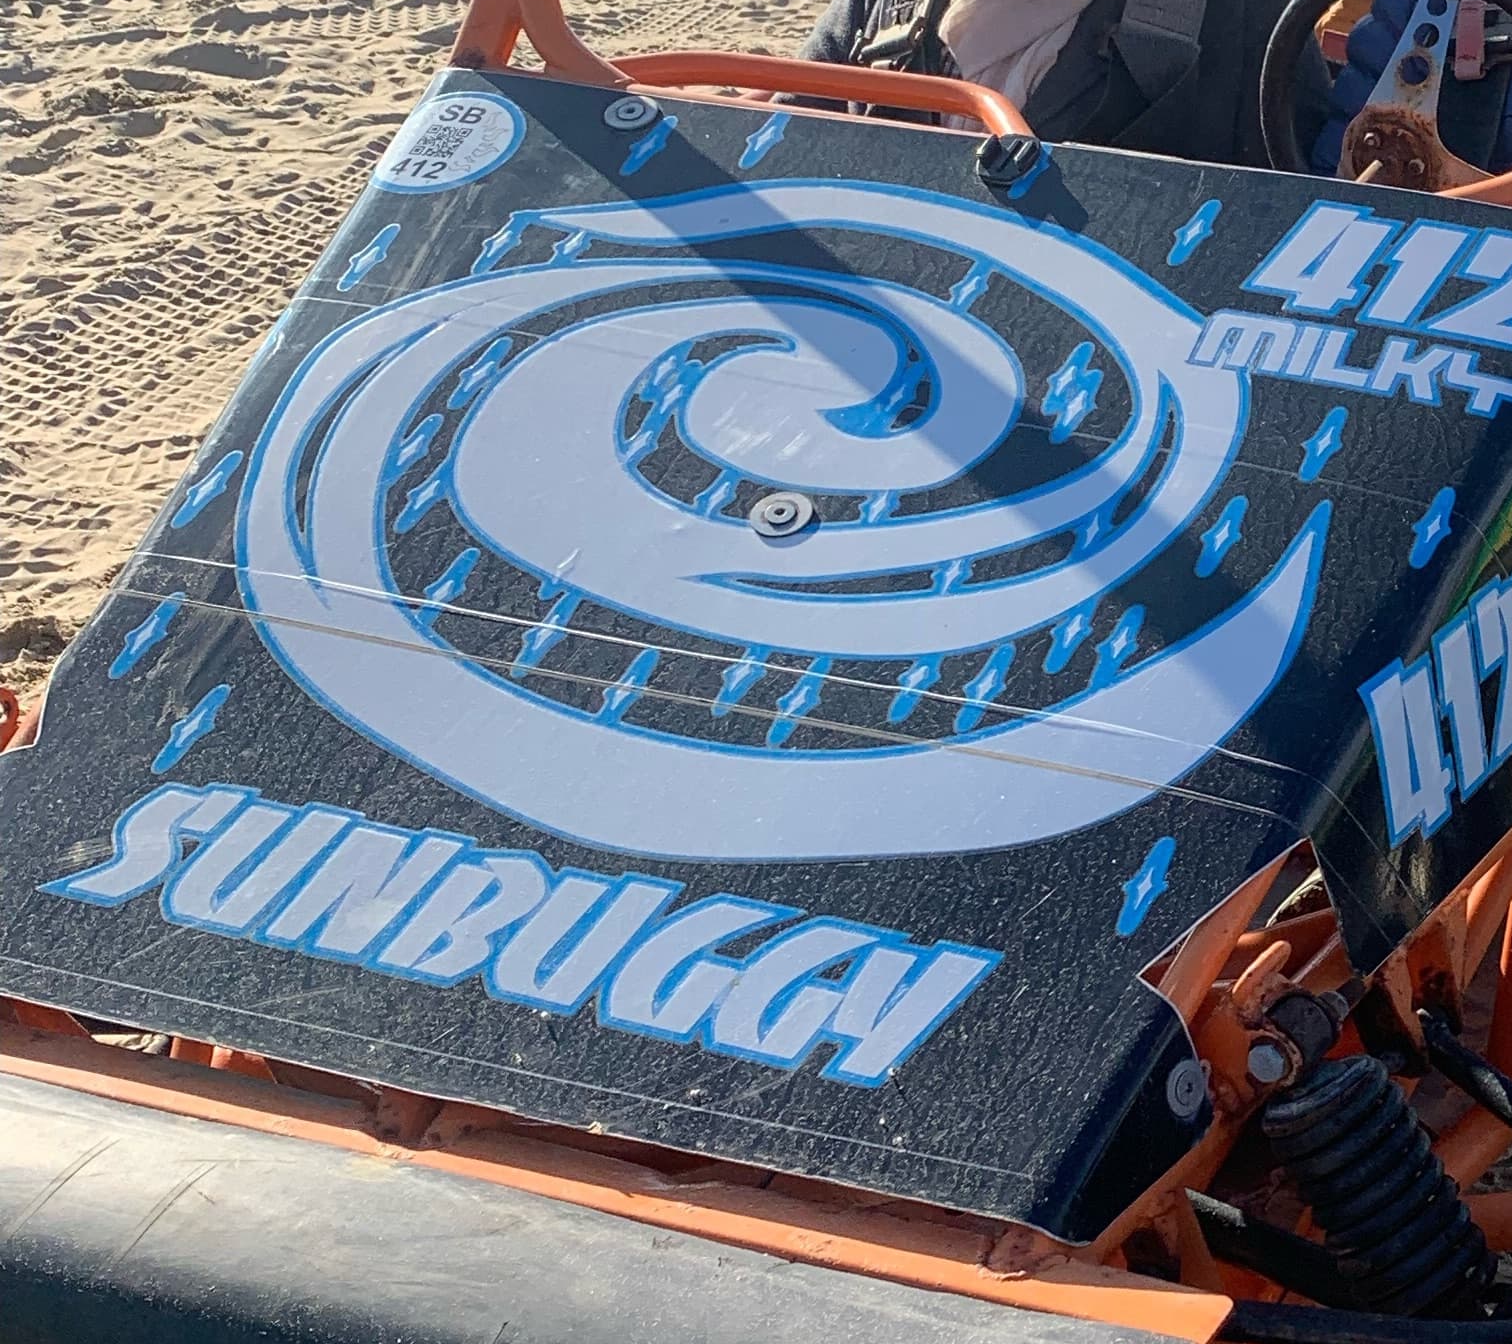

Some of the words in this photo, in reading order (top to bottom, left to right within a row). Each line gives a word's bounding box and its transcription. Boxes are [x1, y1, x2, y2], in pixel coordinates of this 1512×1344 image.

[438, 104, 487, 124] SB
[389, 158, 448, 180] 412
[35, 781, 1005, 1089] SUNBUGGY
